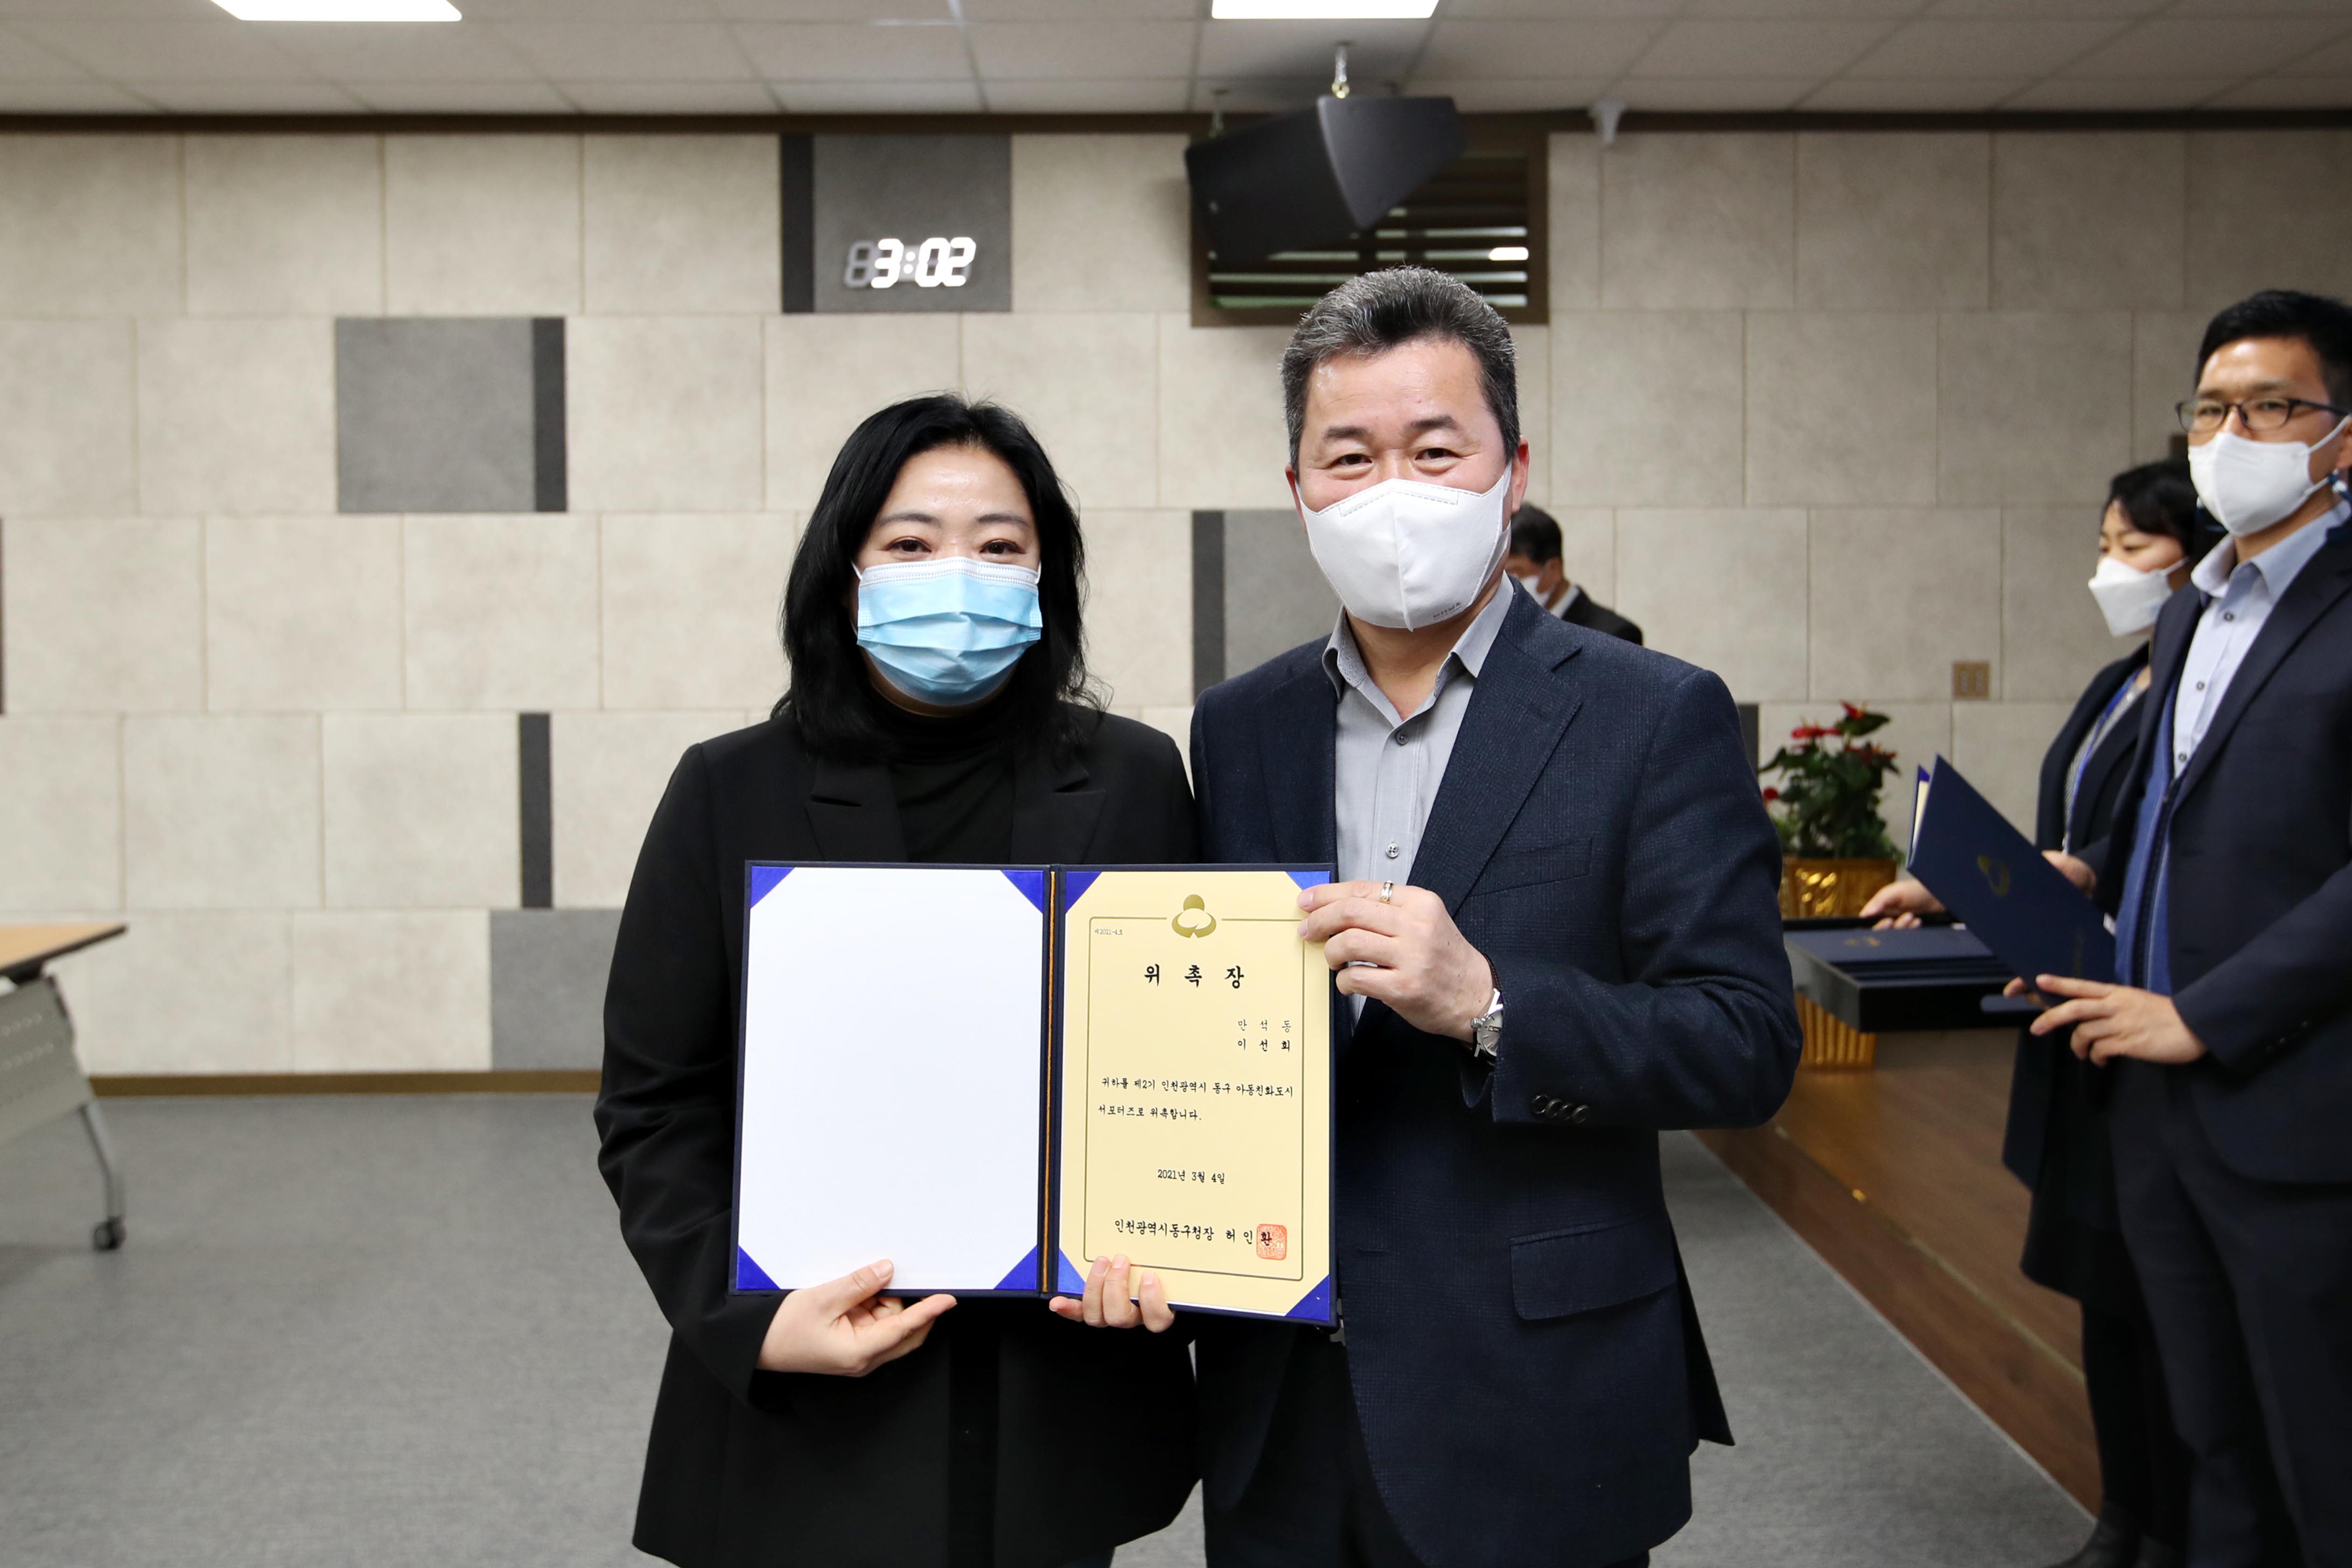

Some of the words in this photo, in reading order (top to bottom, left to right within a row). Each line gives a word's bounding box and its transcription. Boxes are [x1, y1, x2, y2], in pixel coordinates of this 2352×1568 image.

[871, 237, 977, 289] 3:02
[1101, 1076, 1129, 1089] 귀하를
[1133, 1078, 1155, 1090] 제2기
[1161, 1080, 1206, 1093] 인천광역시
[1212, 1082, 1231, 1094] 동구
[1236, 1083, 1293, 1098] 아동친화도시
[1098, 1104, 1145, 1117] 서포터즈로
[1150, 1107, 1202, 1121] 위촉합니다.
[1157, 1169, 1186, 1181] 2021년
[1191, 1171, 1205, 1184] 3월
[1211, 1172, 1225, 1185] 4일
[1115, 1219, 1215, 1241] 인천광역시동구청장
